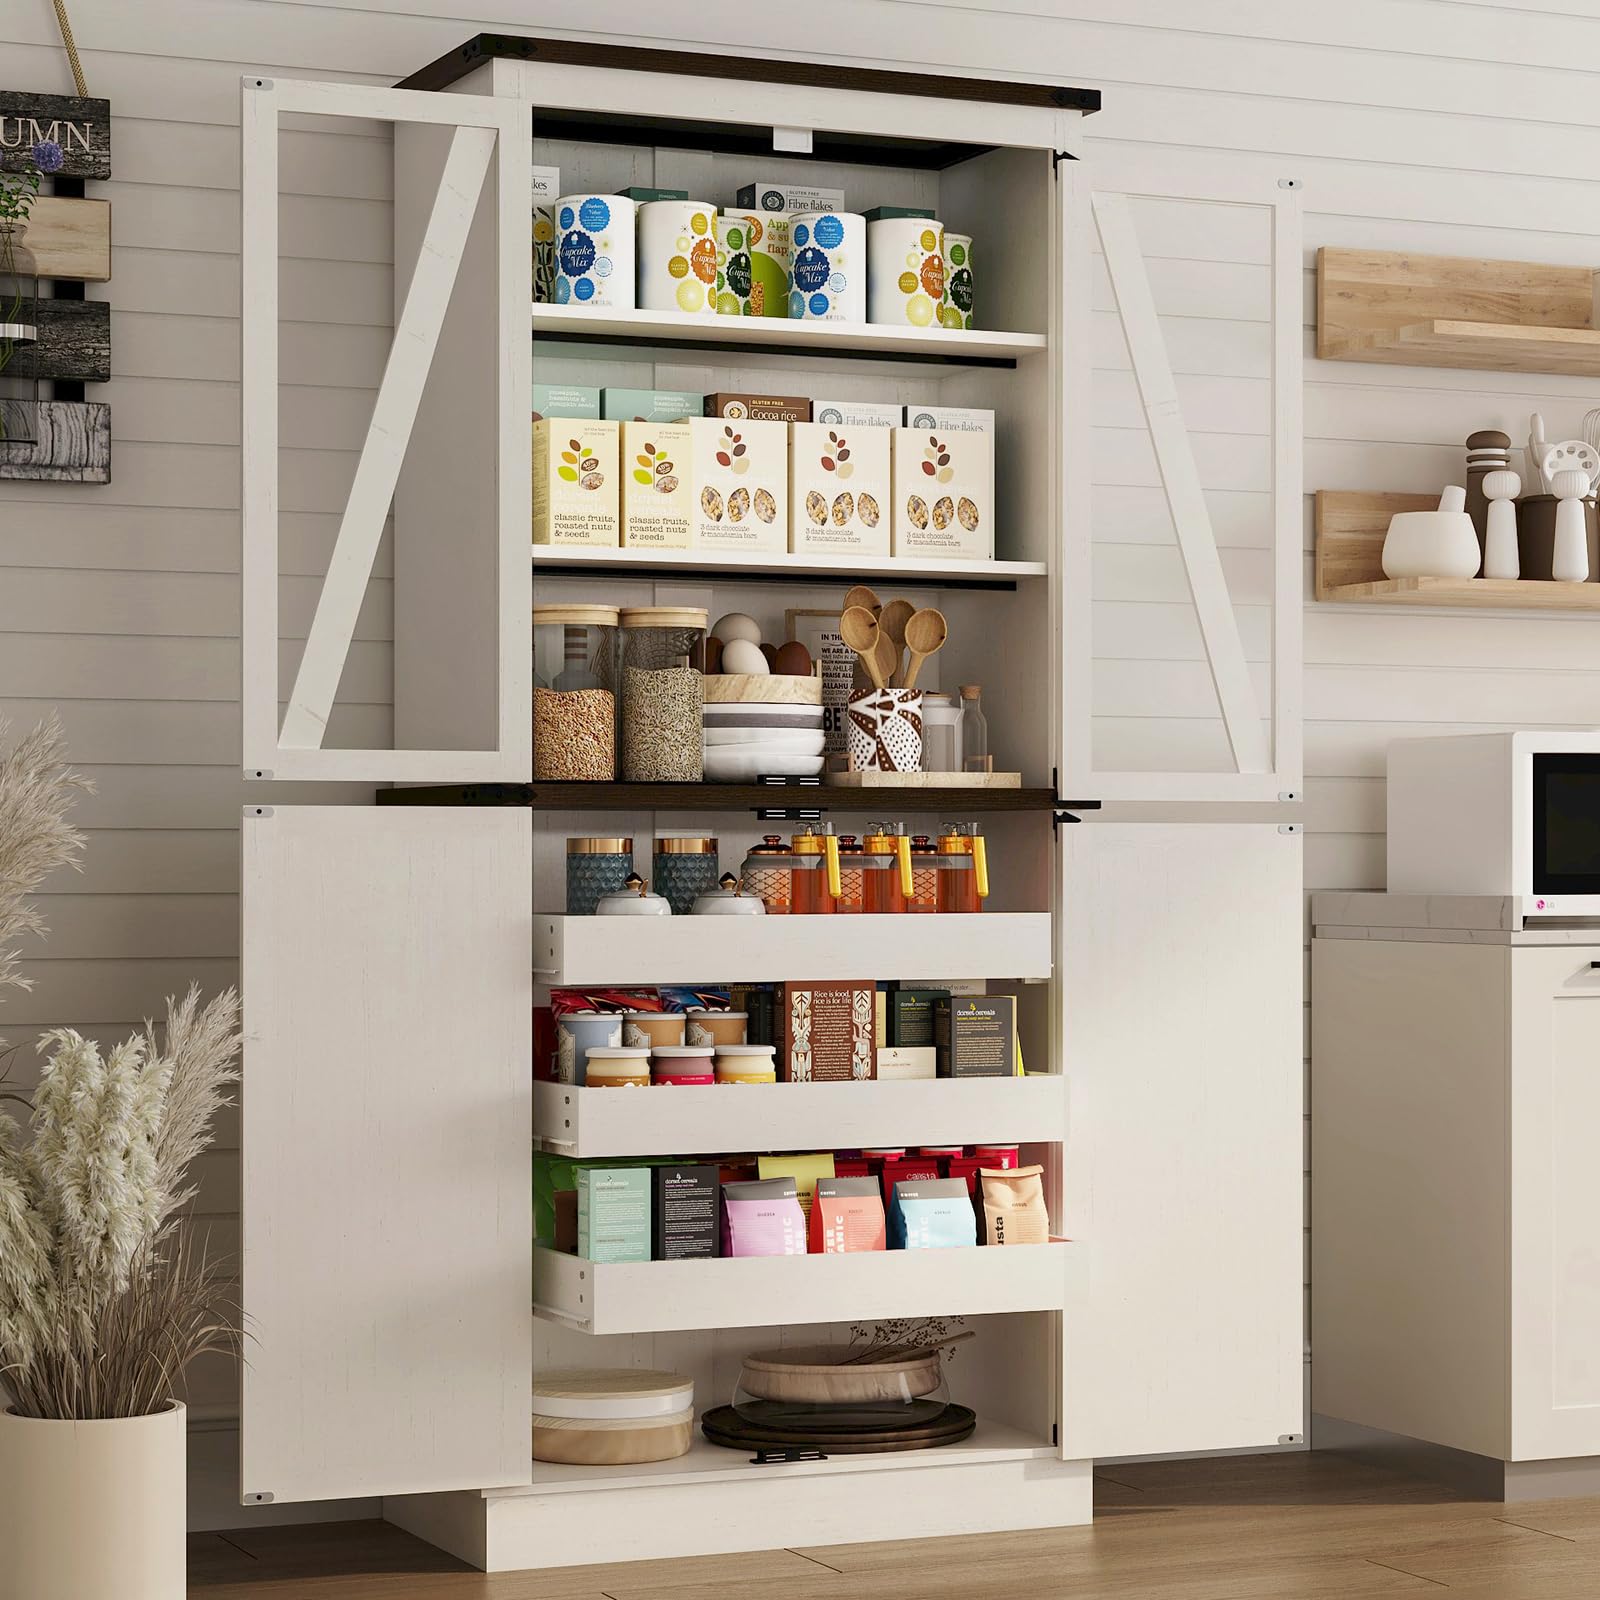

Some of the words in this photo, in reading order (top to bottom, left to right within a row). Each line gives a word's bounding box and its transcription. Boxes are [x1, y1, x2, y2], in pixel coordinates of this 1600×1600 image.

[788, 198, 808, 210] Fibre
[811, 199, 833, 211] flakes
[768, 219, 788, 230] App
[768, 232, 776, 241] &
[561, 245, 592, 260] Cupcake
[571, 257, 588, 267] Mix
[796, 262, 827, 275] Cupcake
[805, 272, 823, 283] Mix
[751, 409, 779, 420] Cocoa
[781, 410, 797, 421] rice
[846, 416, 867, 425] Fibre
[868, 416, 890, 427] flakes
[940, 421, 960, 430] Fibre
[962, 421, 984, 432] flakes
[554, 513, 585, 521] classic
[588, 514, 616, 523] fruits,
[630, 516, 660, 524] classic
[662, 517, 690, 526] fruits,
[639, 533, 665, 541] seeds
[826, 528, 854, 536] chocolate
[926, 532, 953, 540] chocolate
[823, 708, 841, 732] BE
[814, 990, 828, 998] Rice
[835, 990, 850, 998] food,
